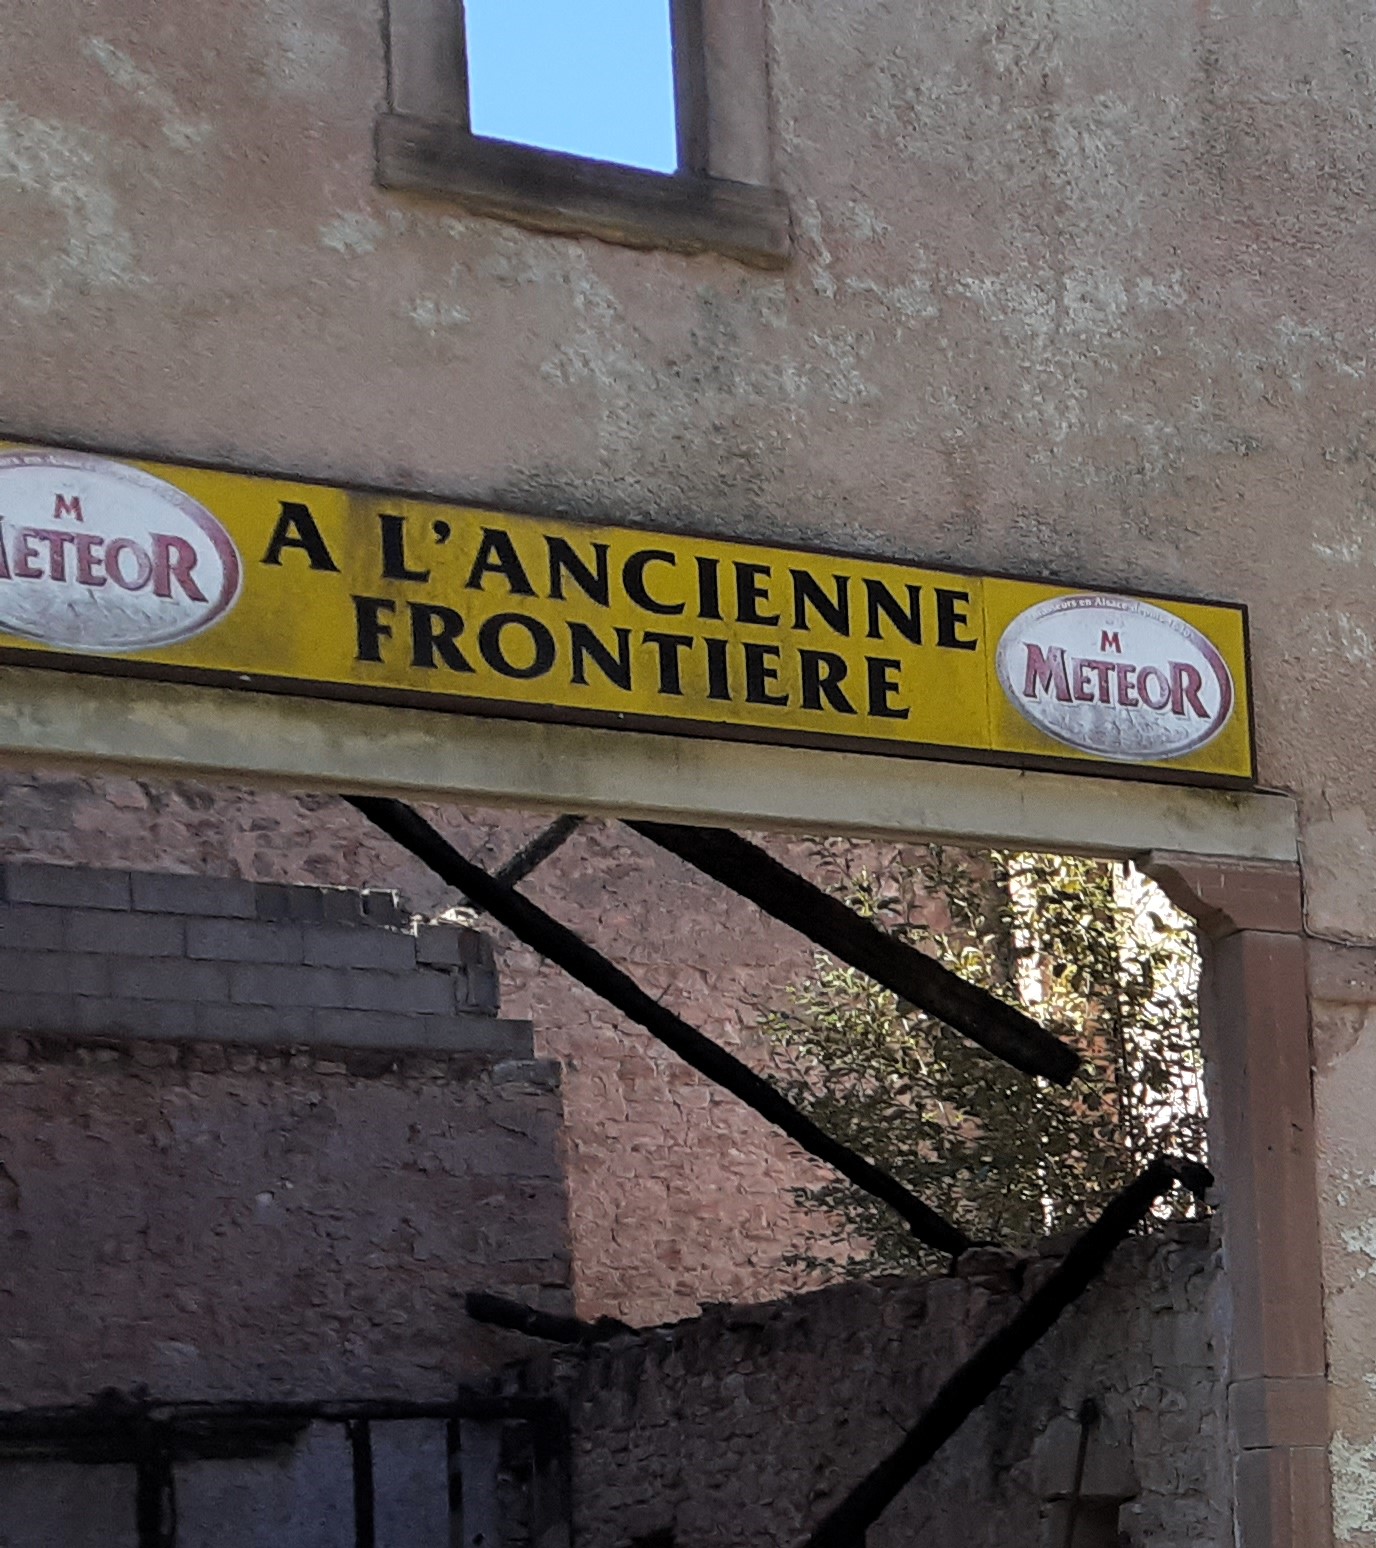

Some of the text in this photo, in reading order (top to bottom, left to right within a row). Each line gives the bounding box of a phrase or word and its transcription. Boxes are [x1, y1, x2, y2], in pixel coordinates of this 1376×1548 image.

[260, 500, 978, 652] A L'ANCIENNE
[1094, 597, 1129, 610] Alsace
[350, 594, 911, 720] FRONTIERE
[1022, 641, 1212, 719] METEOR
